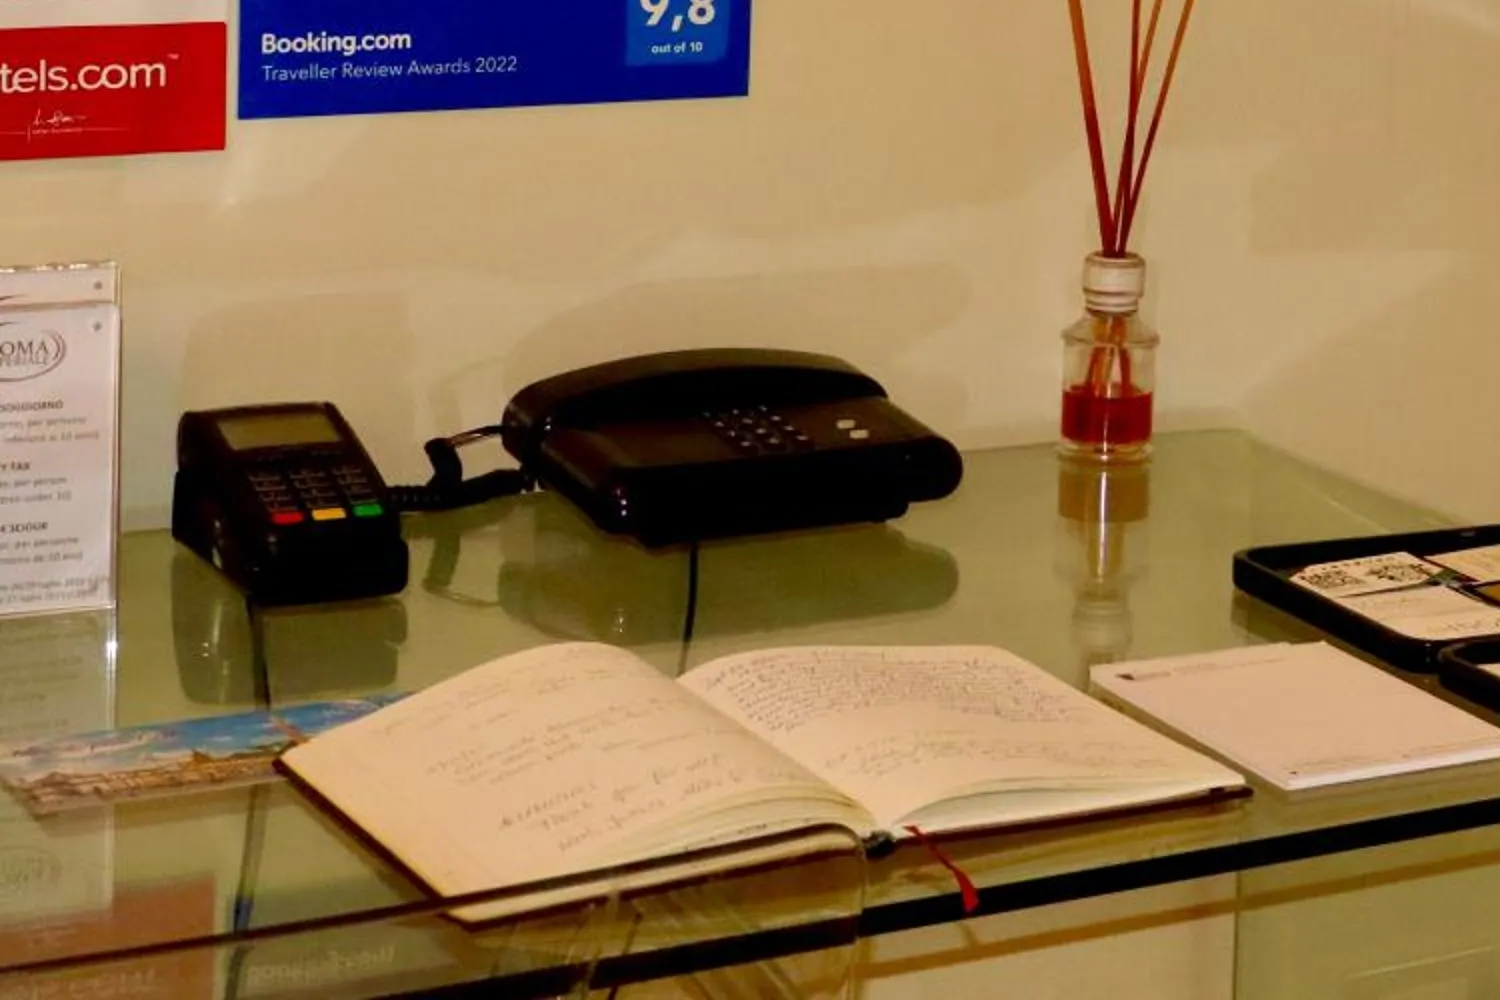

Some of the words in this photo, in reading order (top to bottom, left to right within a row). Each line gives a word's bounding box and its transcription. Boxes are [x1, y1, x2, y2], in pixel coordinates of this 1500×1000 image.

[261, 31, 412, 56] Booking.com
[651, 43, 671, 54] out
[673, 41, 686, 53] of
[689, 41, 703, 53] 10
[262, 63, 336, 81] Traveller
[341, 61, 402, 78] Review
[407, 58, 471, 75] Awards
[475, 55, 518, 73] 2022
